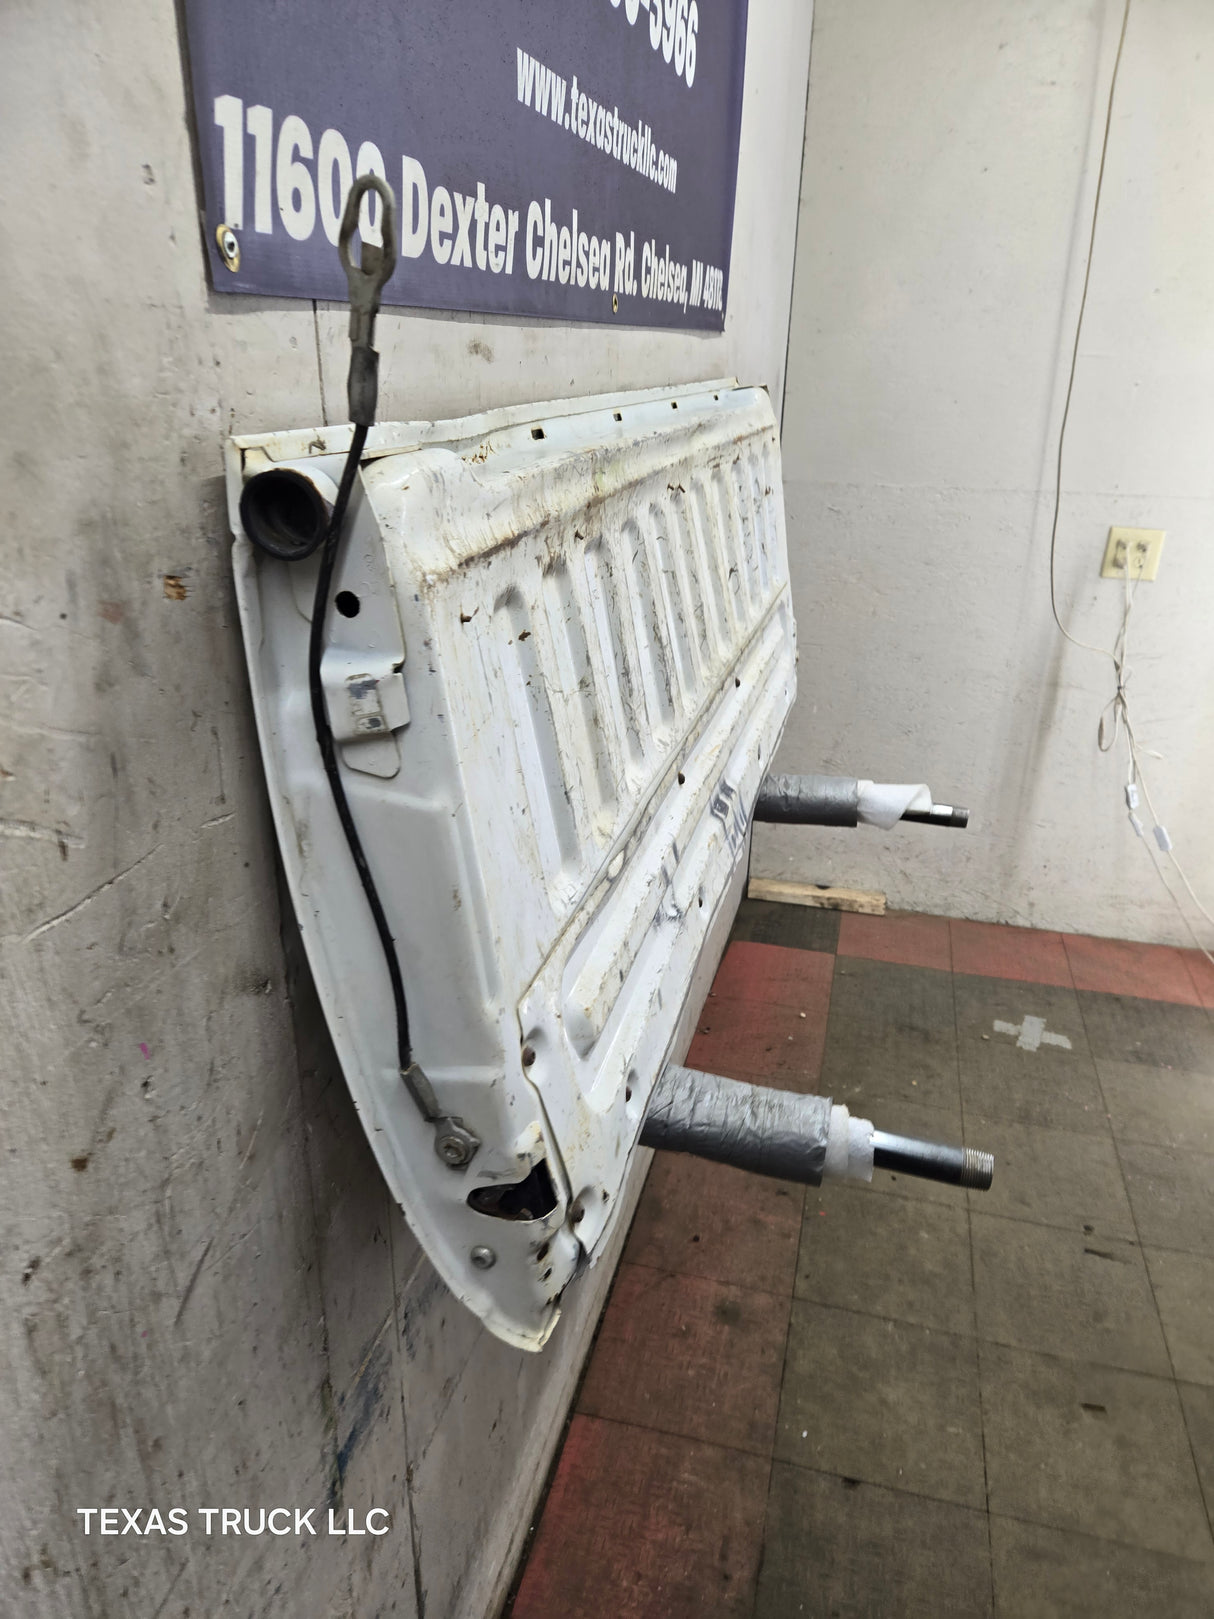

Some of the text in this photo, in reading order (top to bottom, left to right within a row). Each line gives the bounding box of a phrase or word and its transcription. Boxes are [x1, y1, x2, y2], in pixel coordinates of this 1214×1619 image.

[214, 95, 387, 248] 11600
[402, 154, 519, 275] Dexter
[525, 198, 611, 291] Chelsea
[614, 230, 638, 297] Rd.
[641, 239, 688, 315] Chelsea,
[689, 259, 704, 307] MI
[516, 47, 678, 194] www.texastruckllc.com
